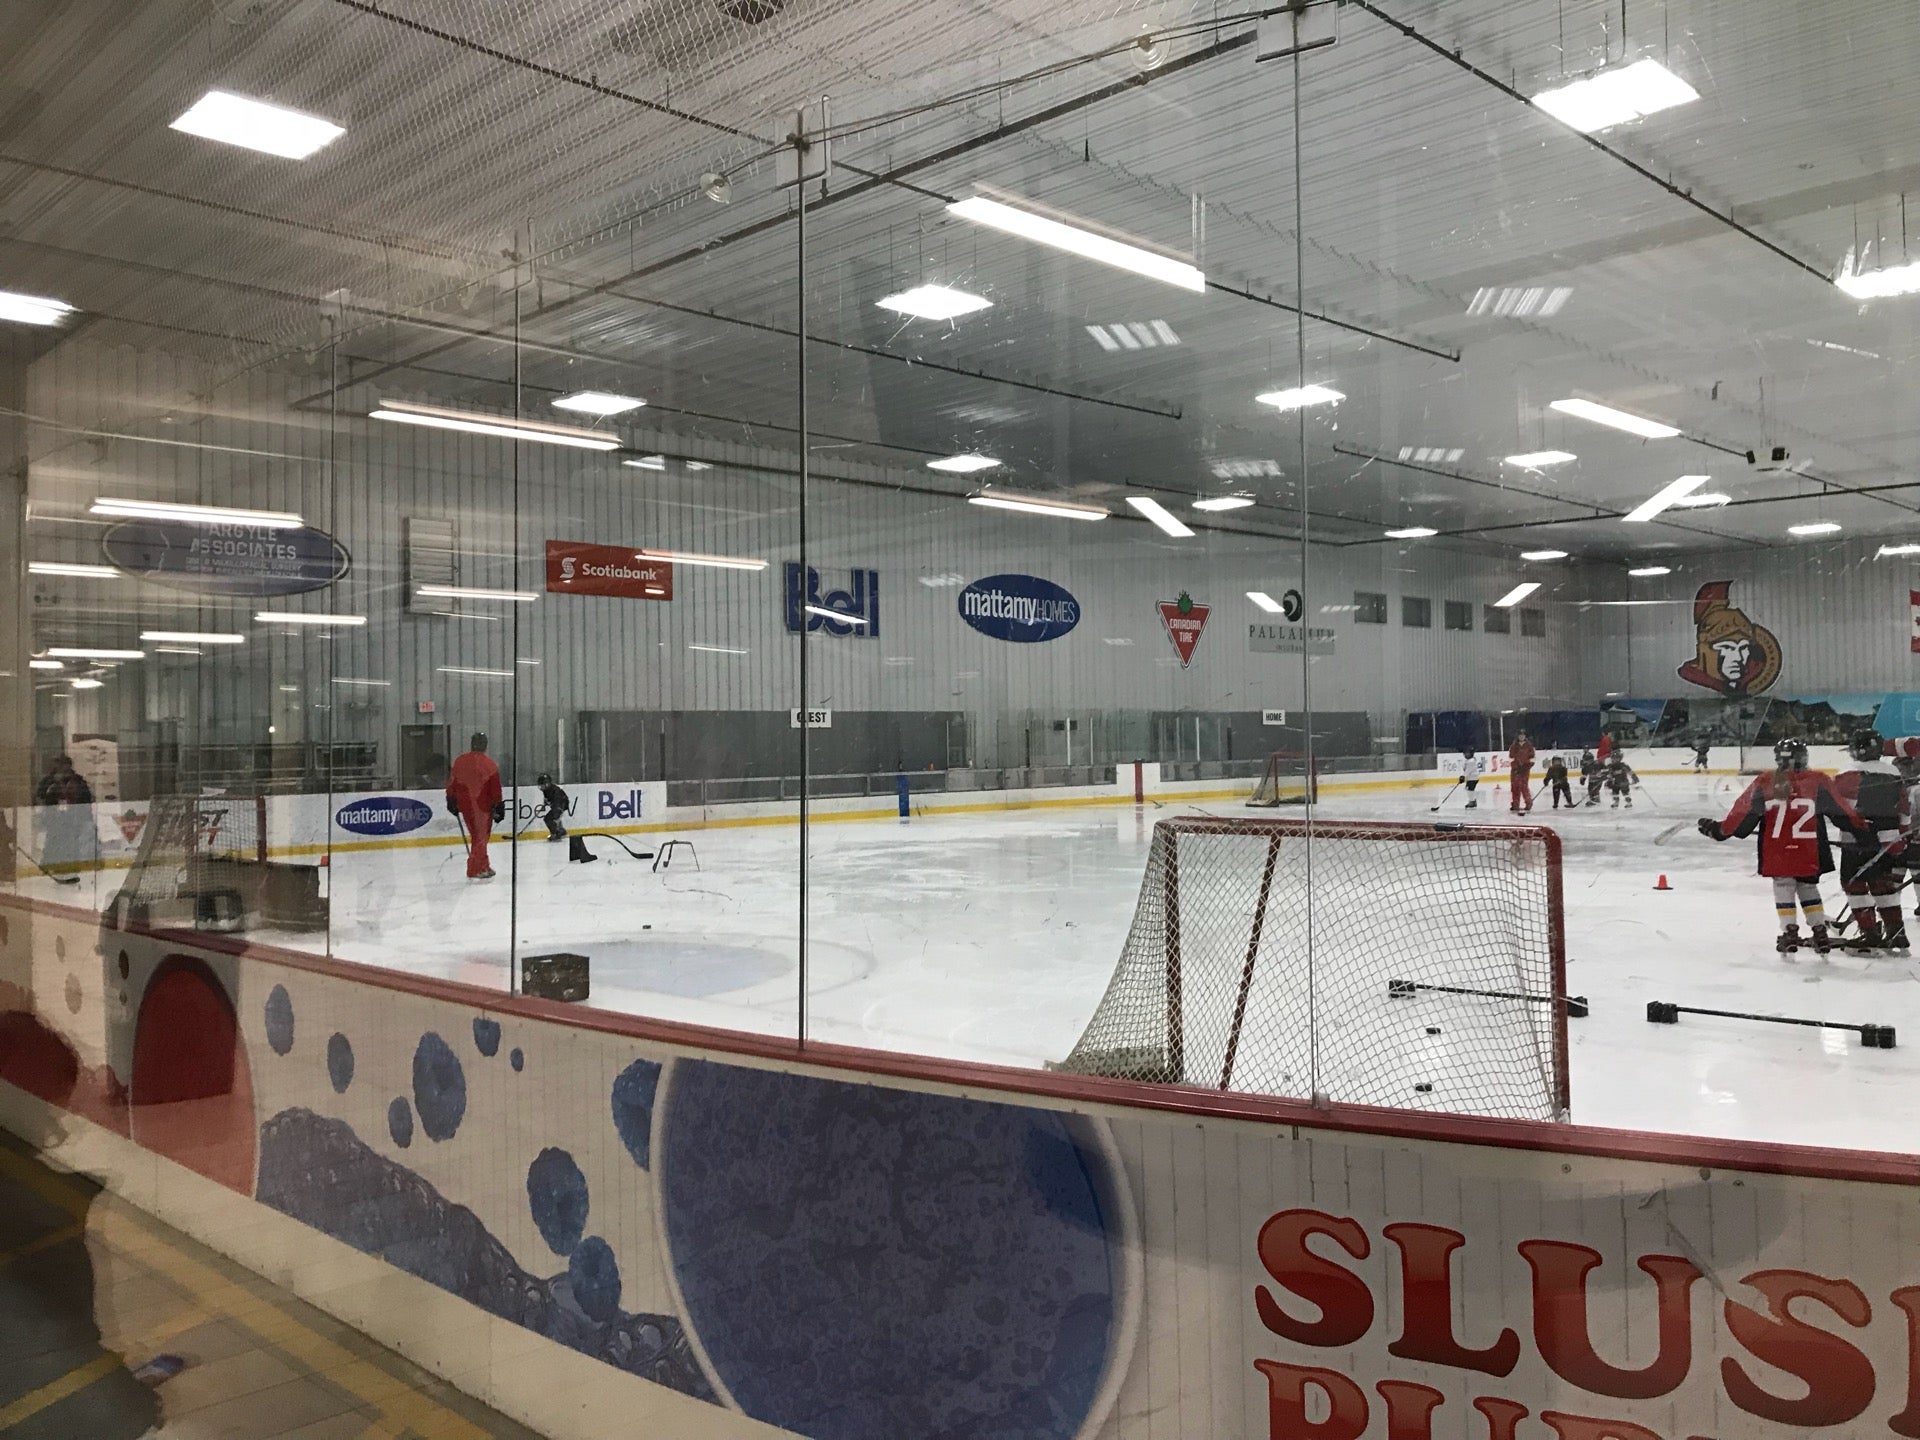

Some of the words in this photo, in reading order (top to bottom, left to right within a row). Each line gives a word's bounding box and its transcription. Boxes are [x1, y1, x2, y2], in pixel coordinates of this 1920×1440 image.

[209, 523, 277, 541] ARGYLE
[190, 538, 297, 560] ASSOCIATES
[582, 563, 657, 580] Scotiabank
[786, 562, 879, 638] Bell
[1169, 618, 1202, 631] CANADIAN
[1179, 632, 1193, 643] TIRE
[796, 711, 827, 723] GEST
[1265, 712, 1282, 722] HOME
[599, 789, 642, 821] Bell
[1764, 797, 1818, 839] 72
